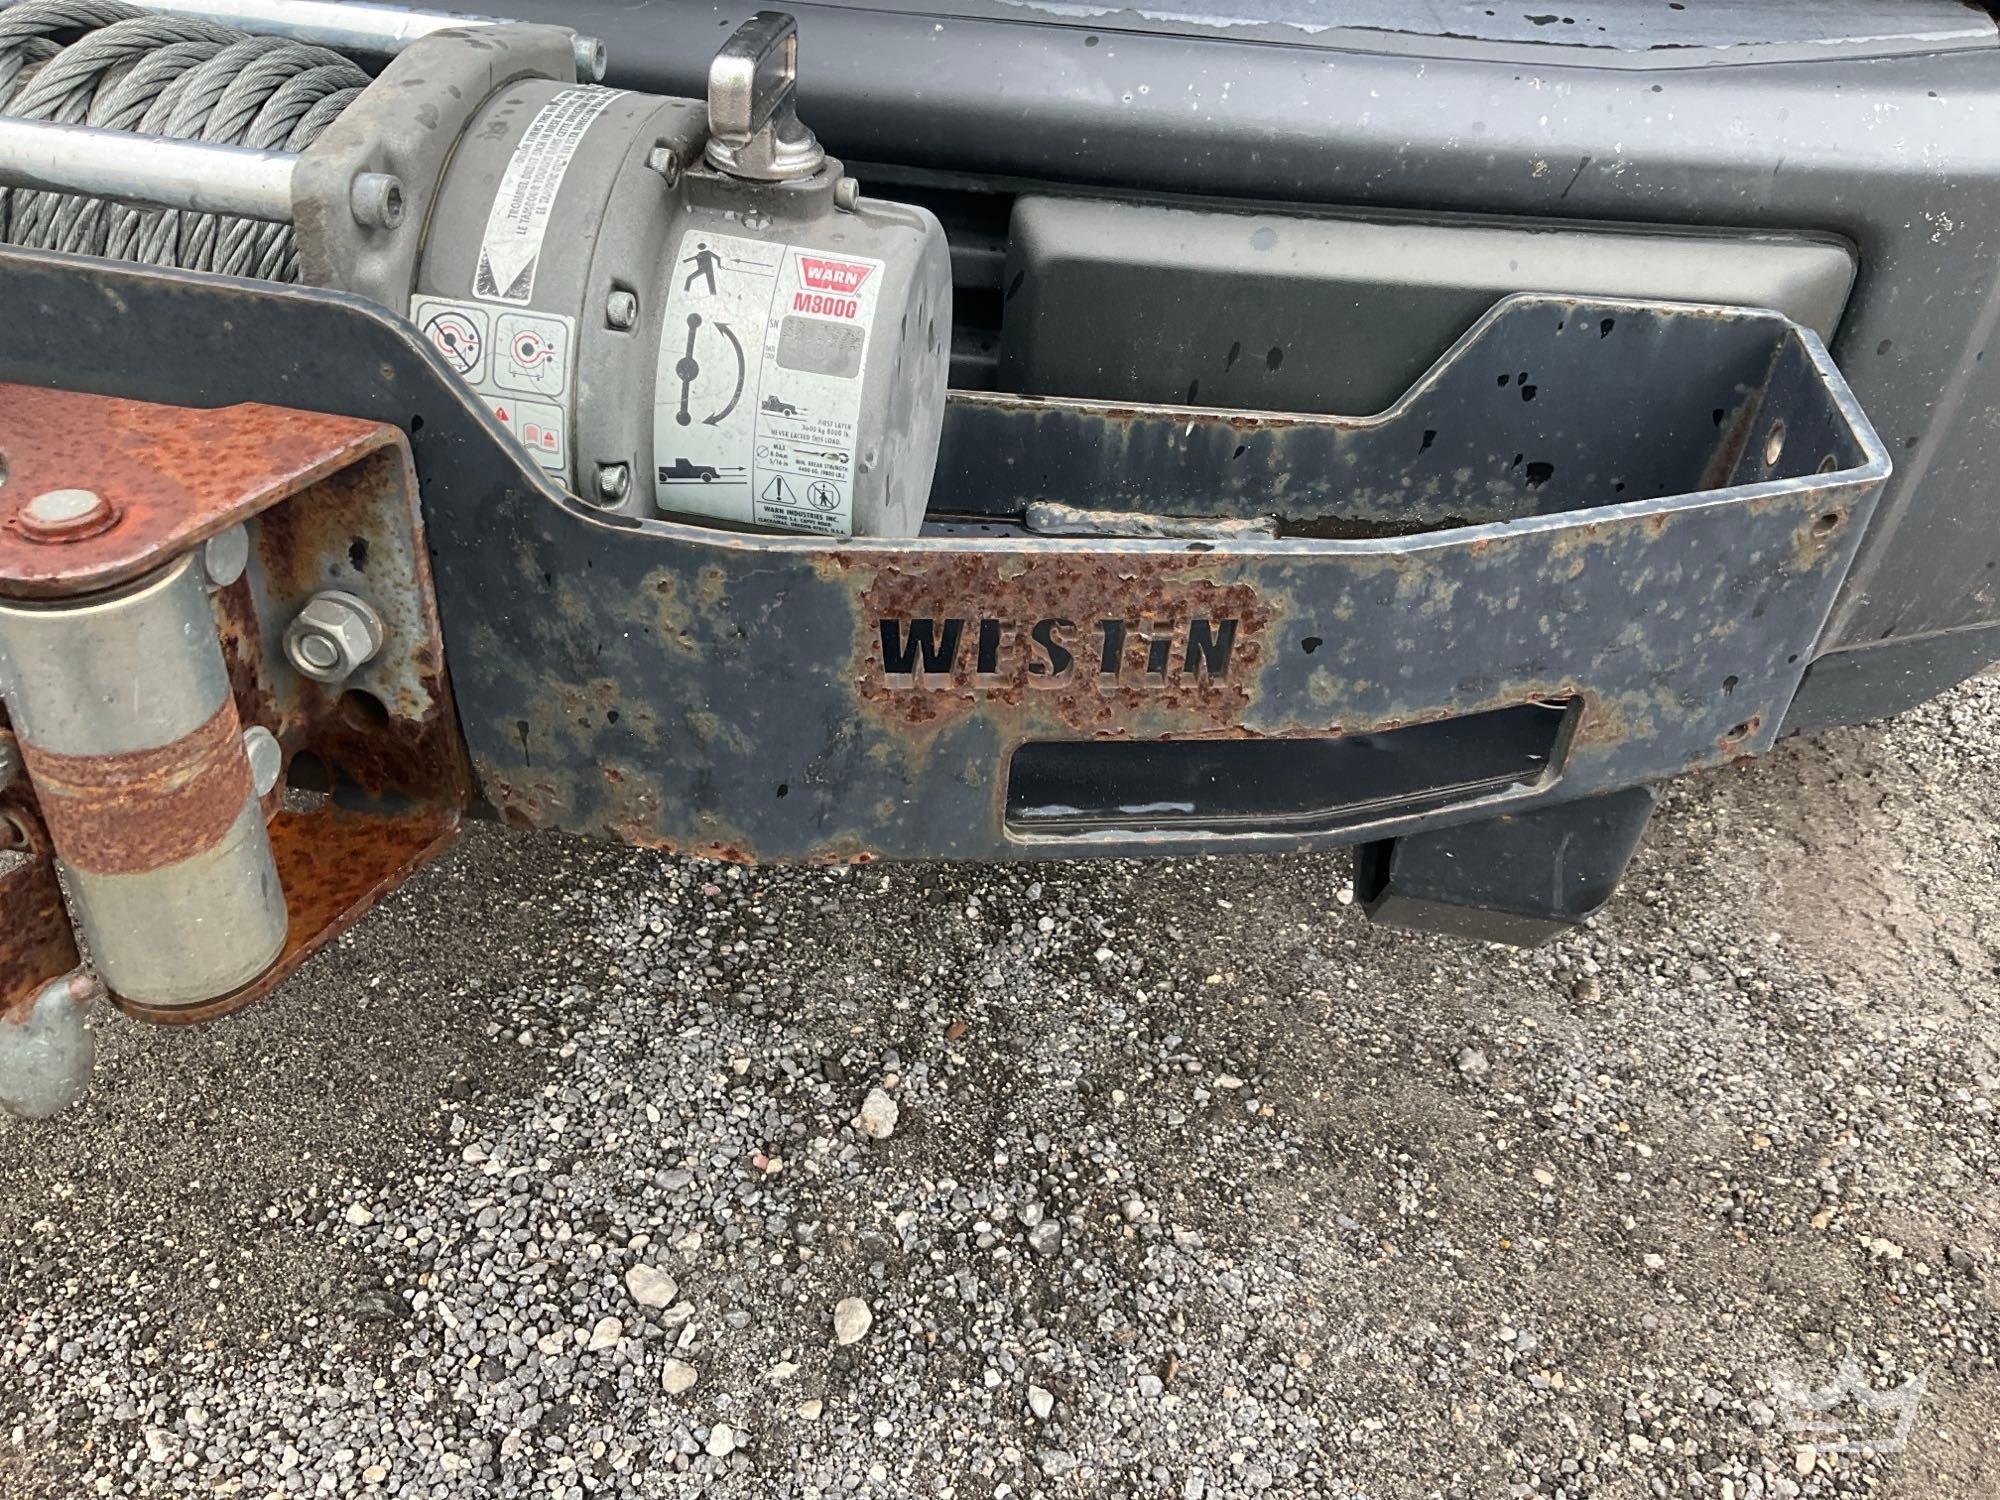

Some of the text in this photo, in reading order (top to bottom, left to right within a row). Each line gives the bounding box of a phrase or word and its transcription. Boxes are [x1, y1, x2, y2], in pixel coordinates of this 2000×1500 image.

[525, 124, 544, 142] TURNS
[537, 113, 551, 123] THIS
[516, 226, 527, 234] LE
[556, 122, 572, 136] CETTE
[807, 266, 859, 285] WARN
[770, 320, 780, 328] SN
[764, 506, 784, 514] WARN
[786, 508, 823, 520] INDUSTRIES
